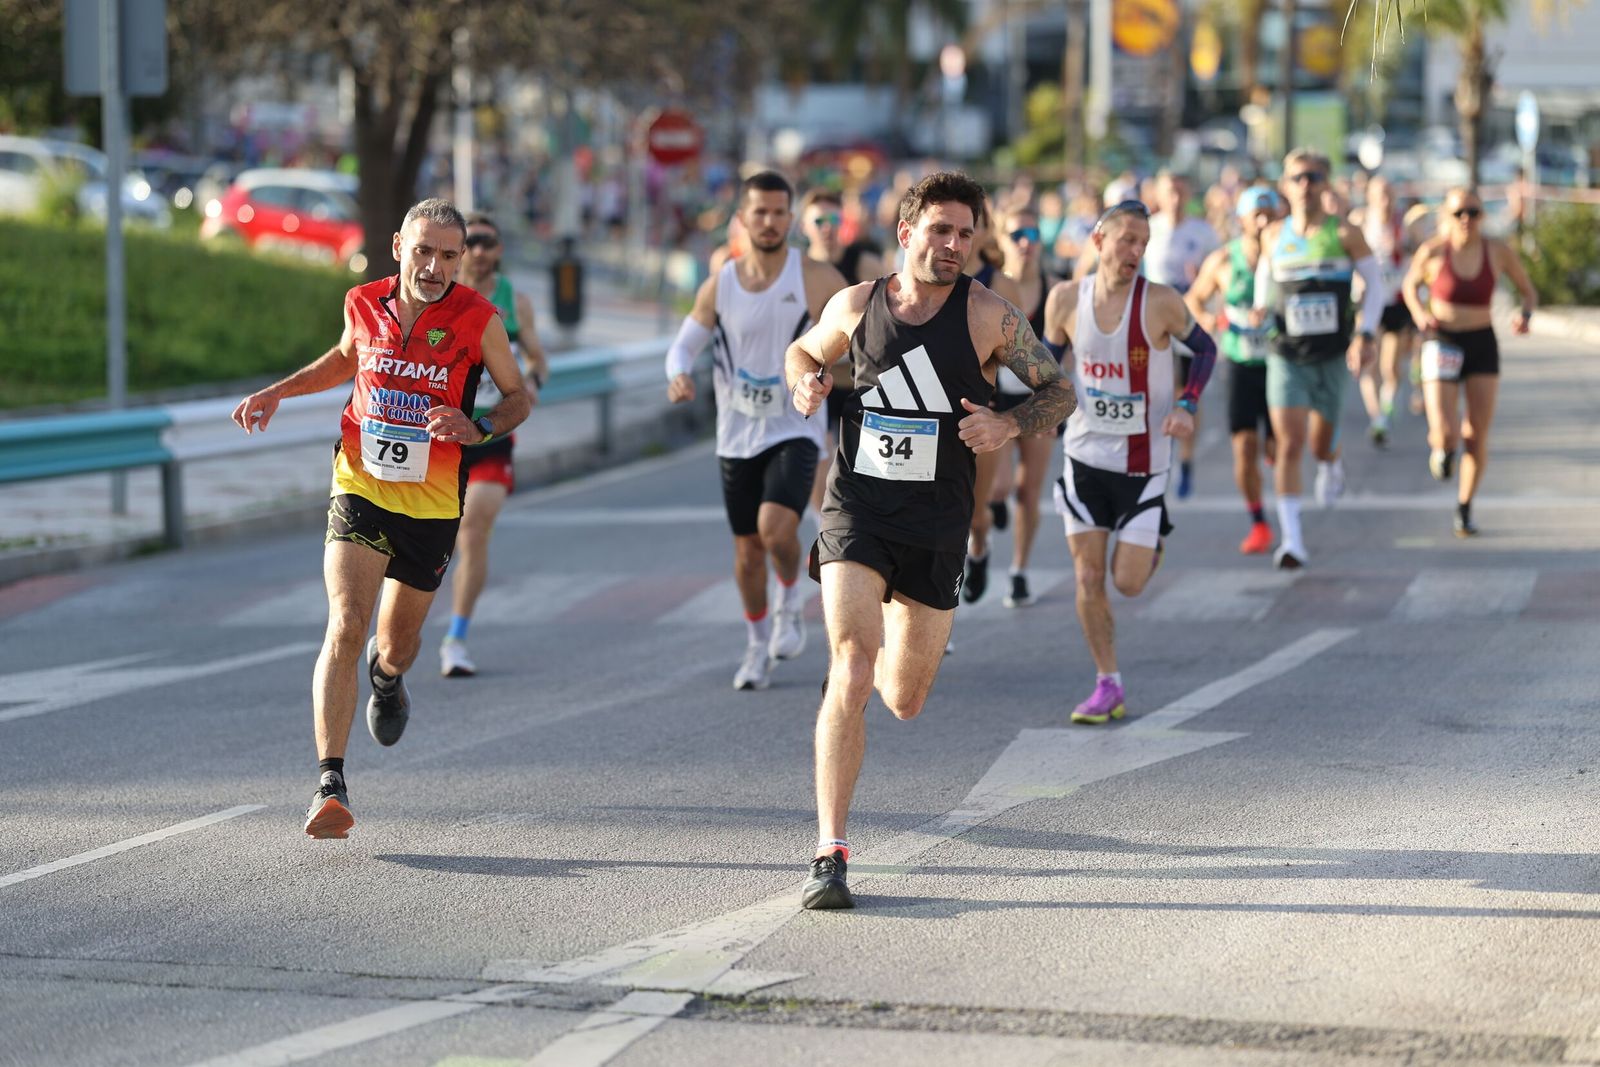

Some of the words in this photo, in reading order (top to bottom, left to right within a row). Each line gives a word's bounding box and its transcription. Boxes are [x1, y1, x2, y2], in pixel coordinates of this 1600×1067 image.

[428, 382, 448, 391] TRAIL
[1094, 399, 1135, 419] 933
[376, 439, 409, 464] 79
[878, 434, 914, 460] 34
